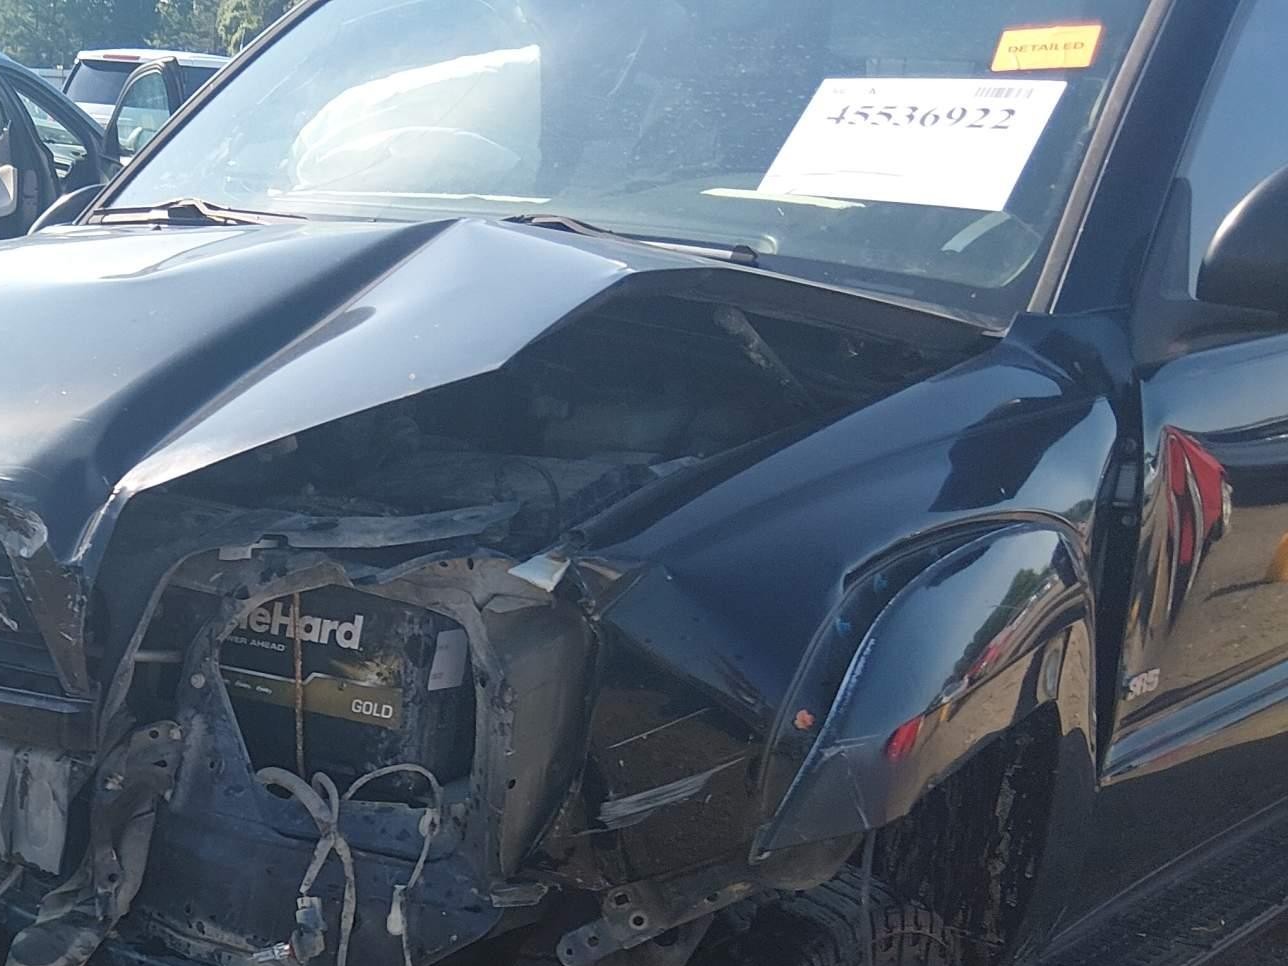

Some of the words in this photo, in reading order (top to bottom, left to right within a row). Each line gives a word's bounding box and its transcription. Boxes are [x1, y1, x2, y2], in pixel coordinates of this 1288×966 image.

[1007, 40, 1085, 55] DETAILED
[826, 104, 1017, 131] 45536922
[249, 639, 286, 652] AHEAD
[351, 699, 393, 719] GOLD
